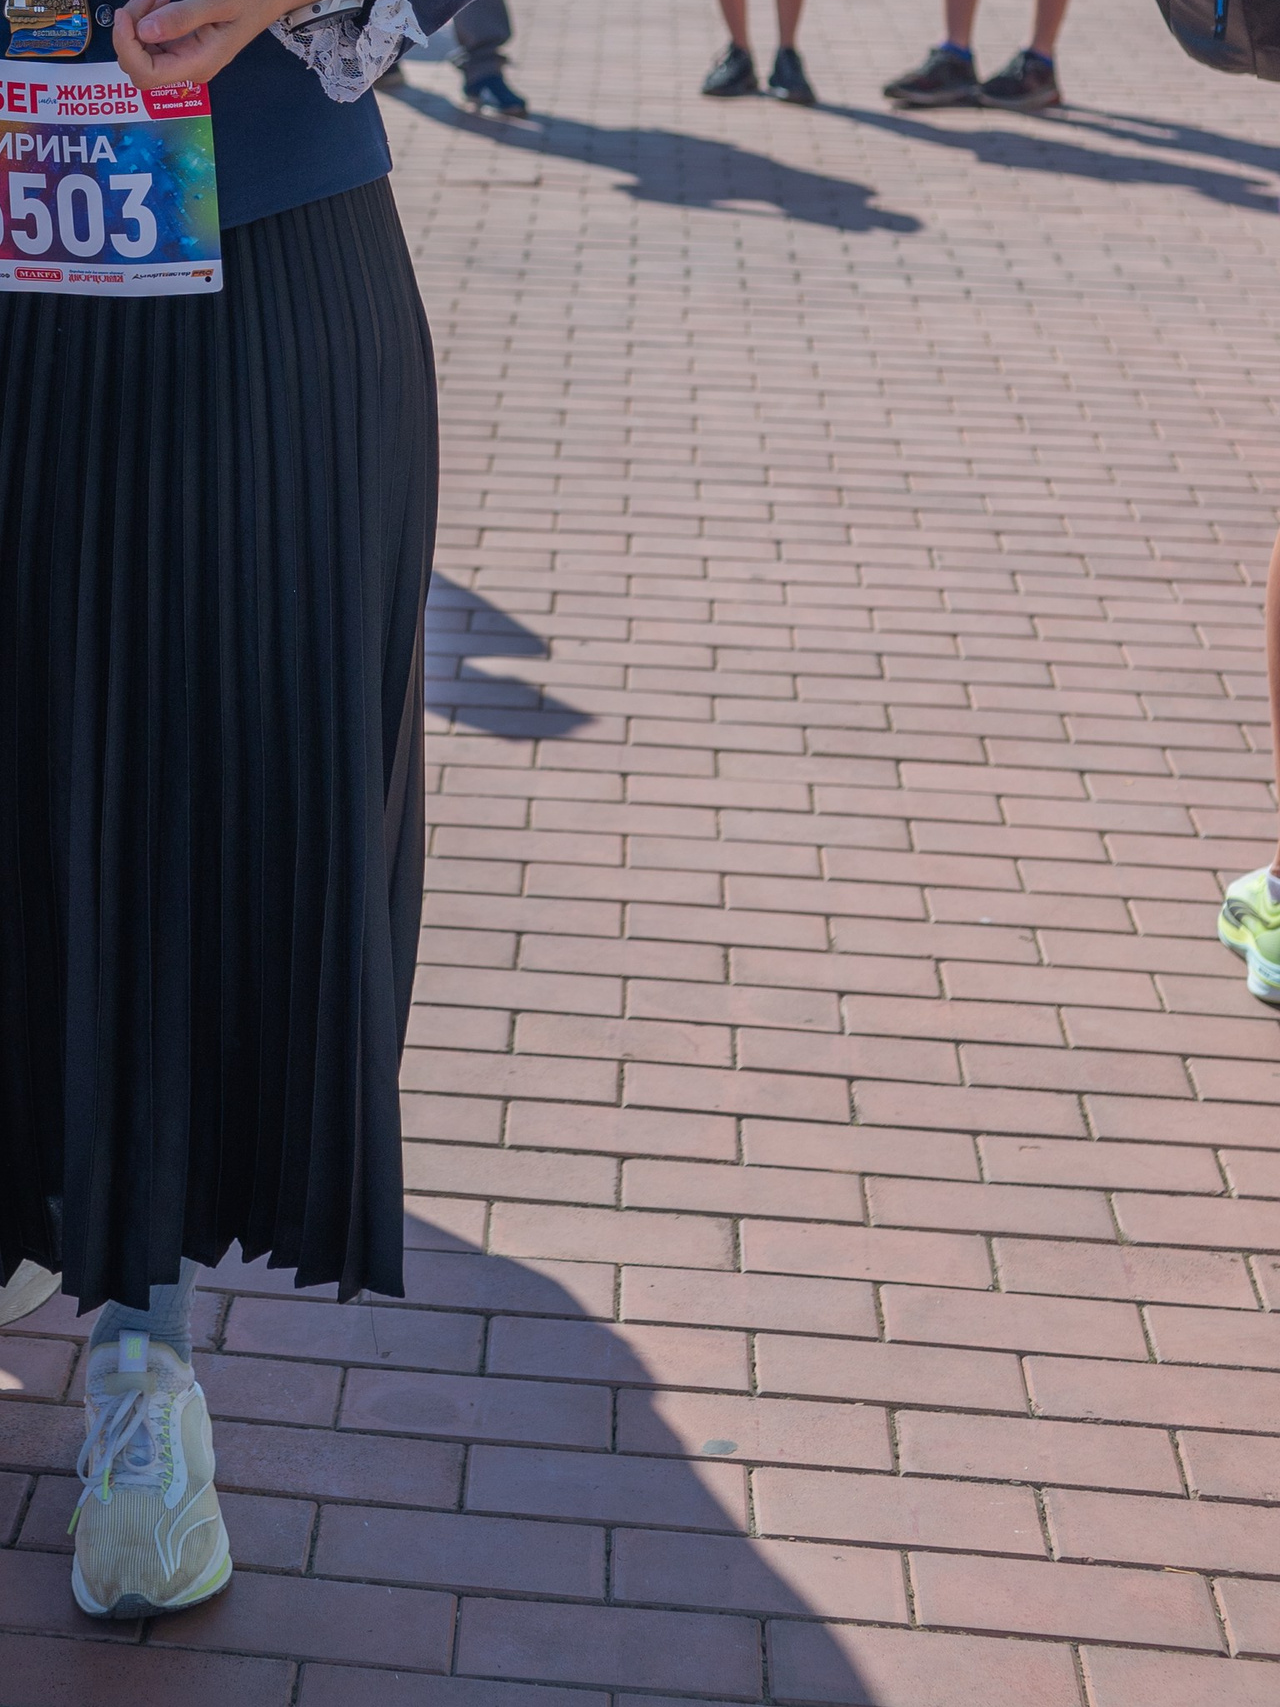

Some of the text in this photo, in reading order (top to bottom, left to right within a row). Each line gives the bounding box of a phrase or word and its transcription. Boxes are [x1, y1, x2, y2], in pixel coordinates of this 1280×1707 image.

[56, 82, 138, 101] ЖИЗНЬ
[150, 89, 178, 97] СПОРТА
[57, 101, 139, 116] ЛЮБОВЬ
[153, 102, 161, 110] 12
[184, 99, 203, 107] 2024
[19, 270, 59, 279] MAKFA
